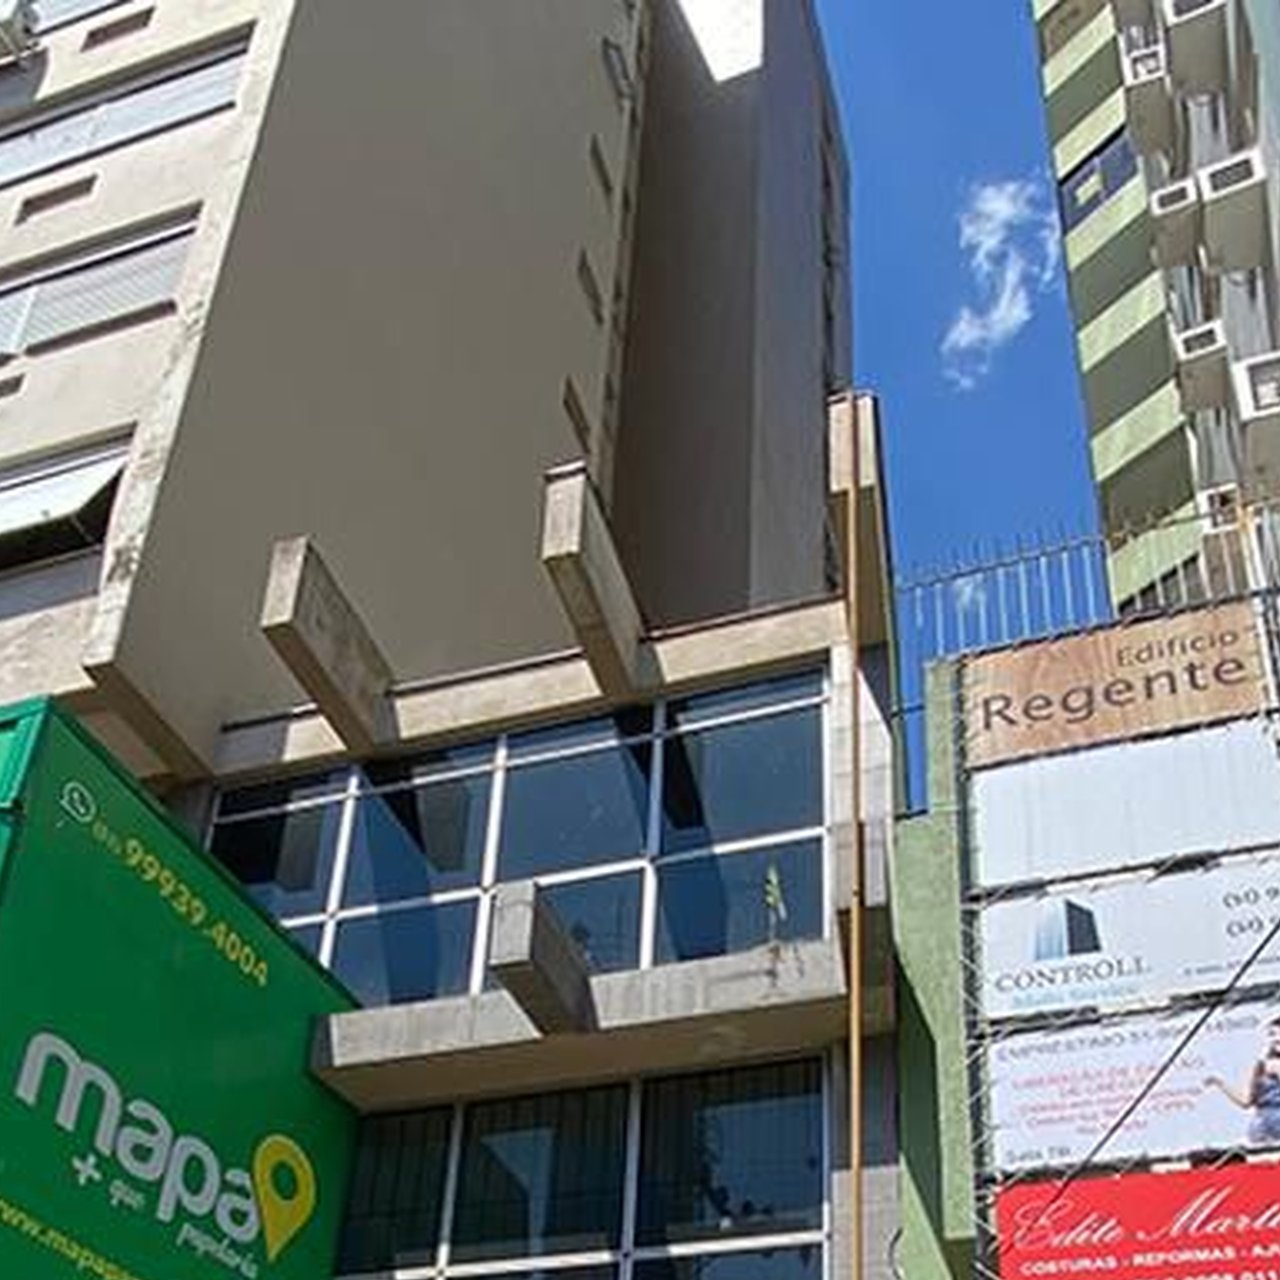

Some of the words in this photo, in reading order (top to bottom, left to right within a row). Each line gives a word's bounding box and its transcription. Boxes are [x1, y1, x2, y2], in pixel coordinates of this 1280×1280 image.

[980, 655, 1248, 731] Regente
[123, 838, 270, 987] 99939.4004
[14, 1030, 261, 1244] mapa
[1020, 1256, 1118, 1276] COSTURAS
[1131, 1245, 1237, 1268] REFORMAS
